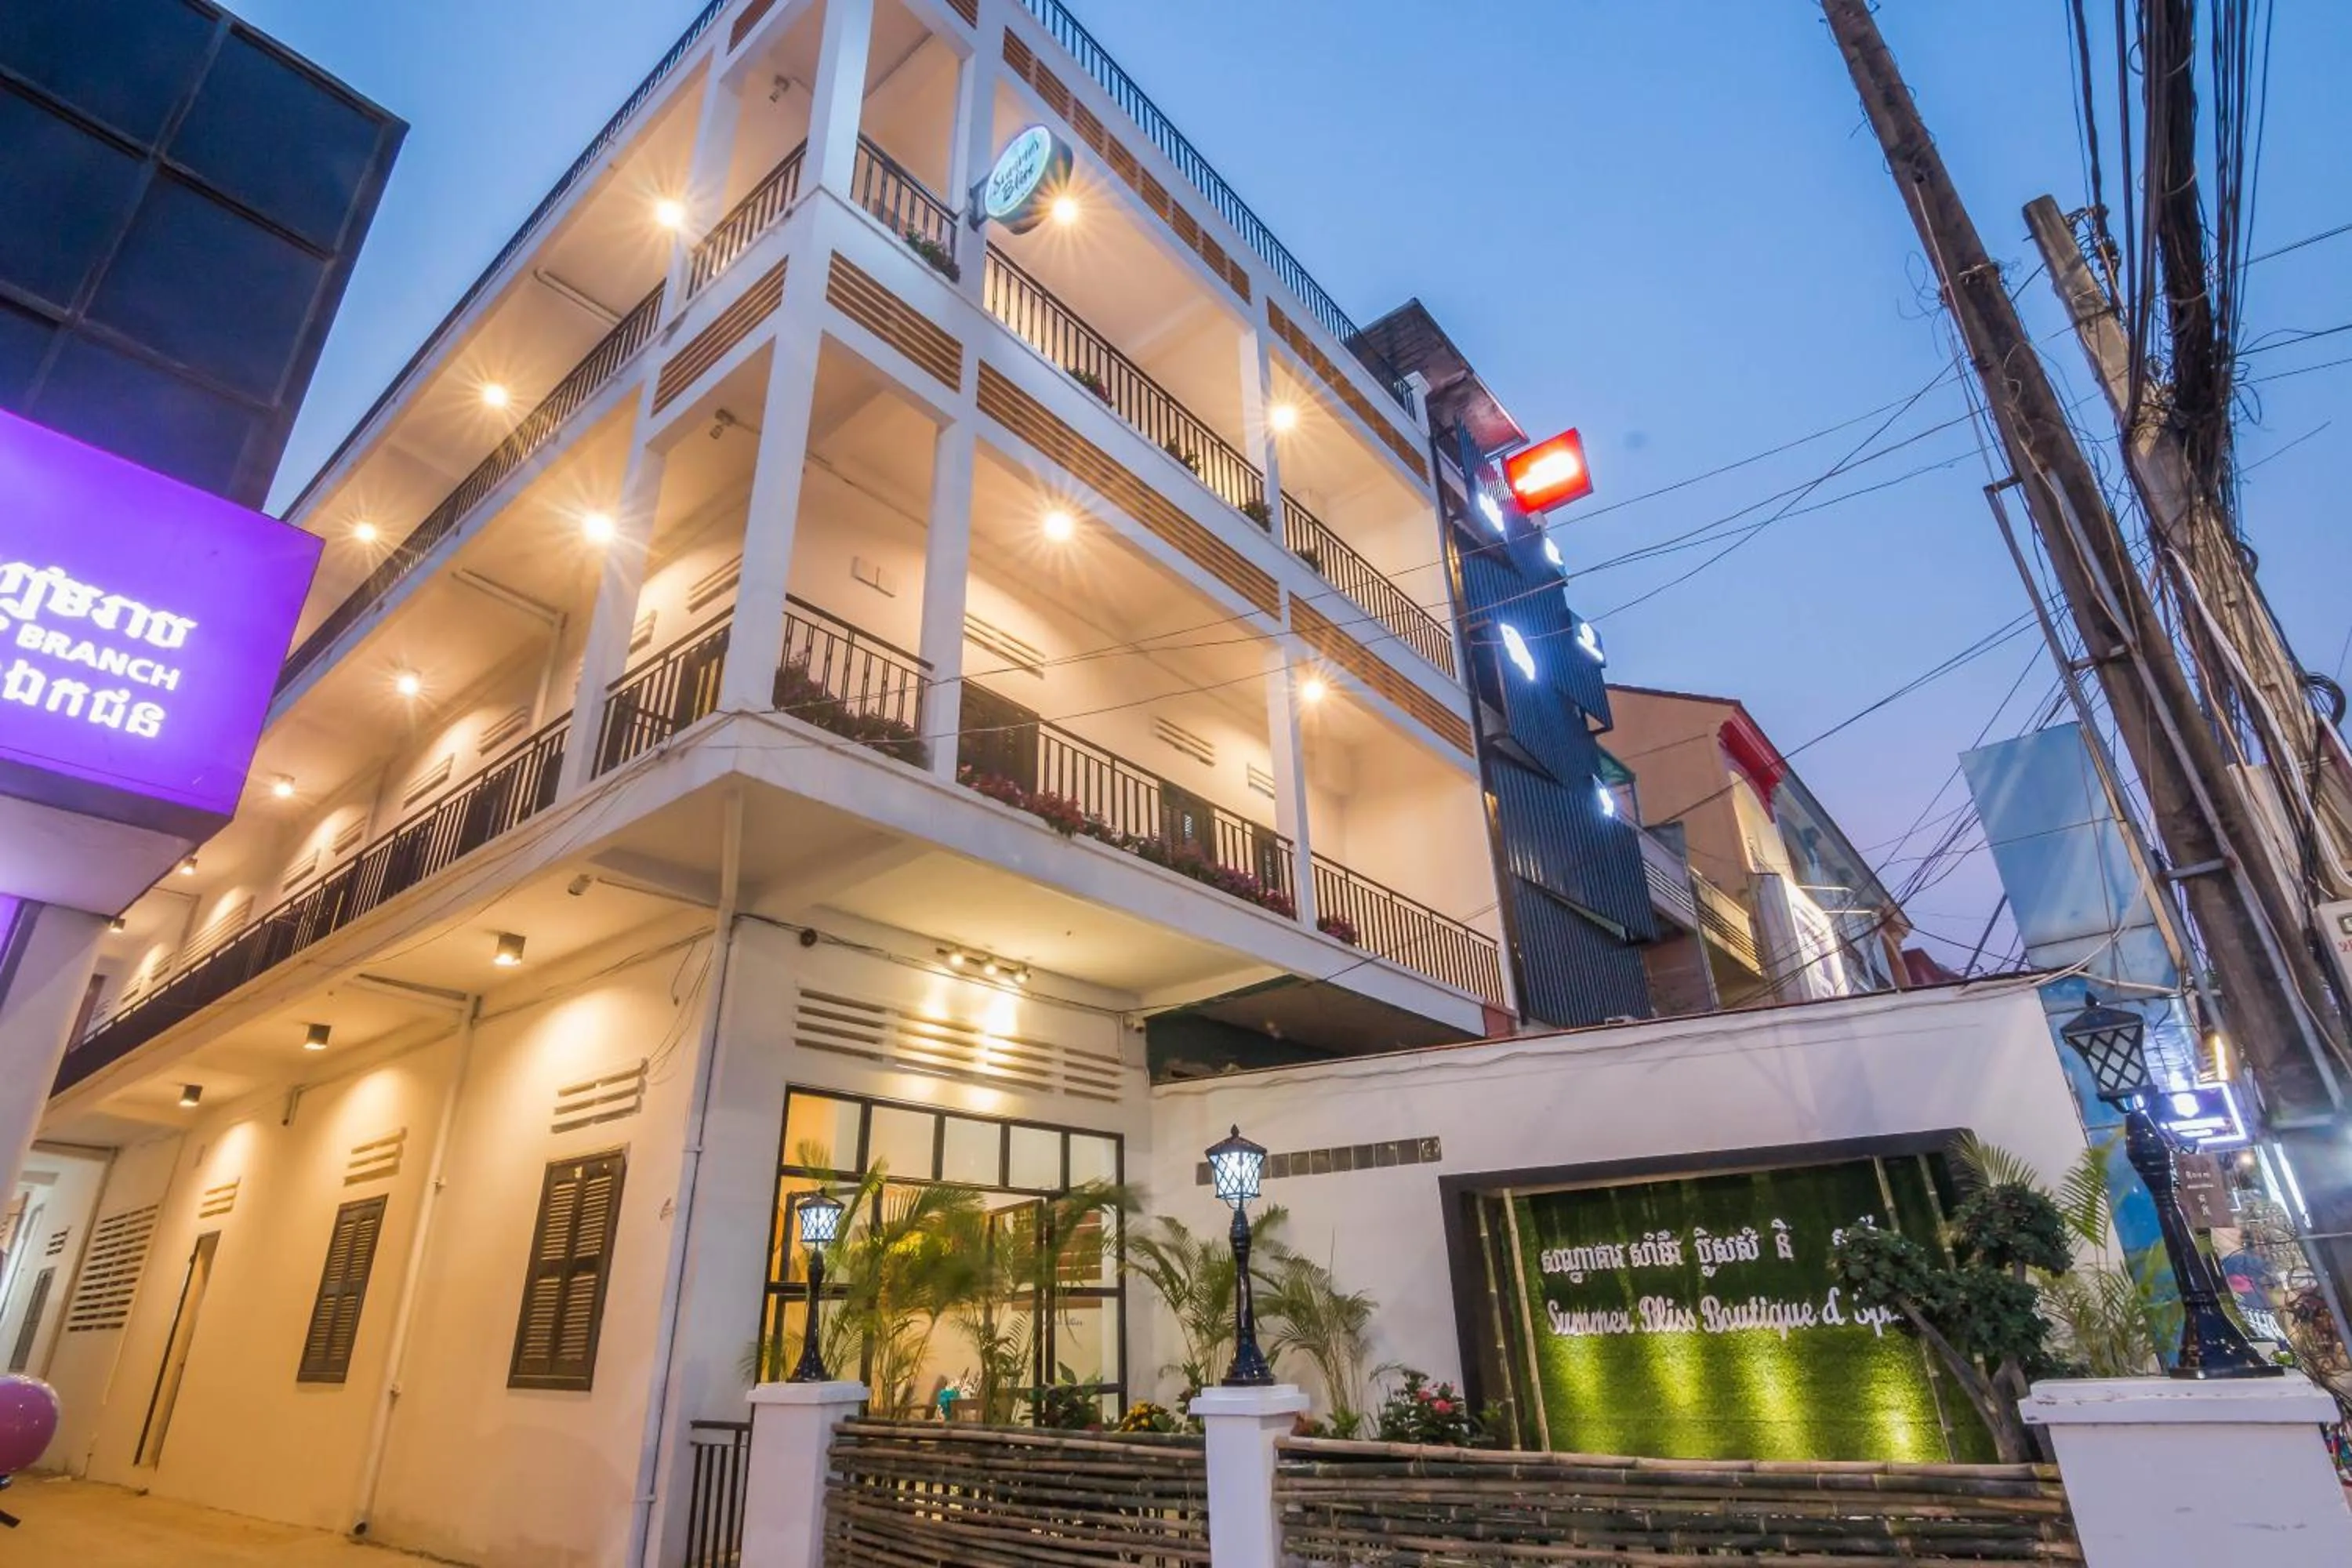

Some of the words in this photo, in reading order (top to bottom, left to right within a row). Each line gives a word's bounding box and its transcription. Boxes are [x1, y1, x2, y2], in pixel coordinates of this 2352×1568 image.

[16, 622, 181, 691] BRANCH
[1548, 1299, 1635, 1336] Summer
[1639, 1296, 1697, 1332] Bliss
[1700, 1295, 1817, 1341] Boutique
